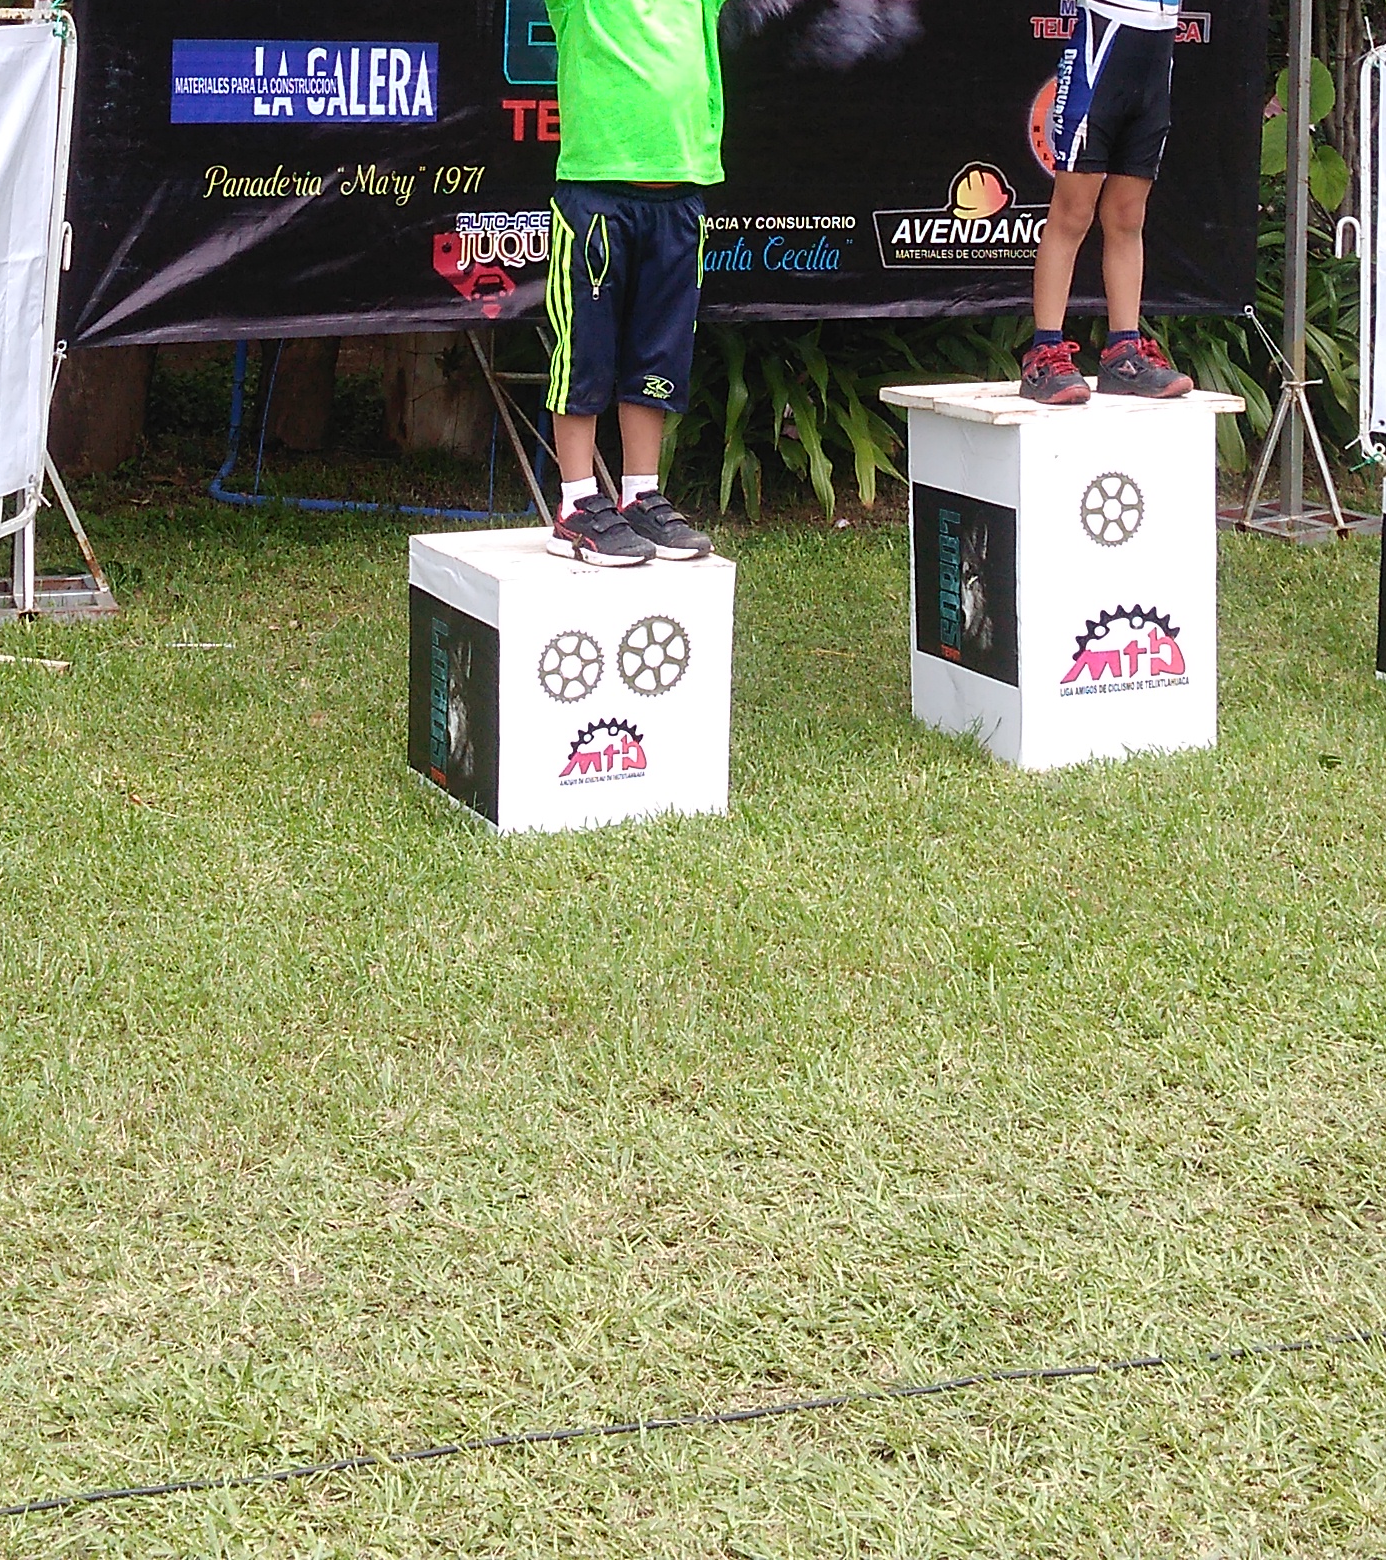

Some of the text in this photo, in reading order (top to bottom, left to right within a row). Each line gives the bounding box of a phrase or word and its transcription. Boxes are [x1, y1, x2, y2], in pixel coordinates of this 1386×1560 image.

[175, 76, 230, 95] MATERIALES
[231, 77, 255, 95] PARA
[257, 78, 269, 95] LA
[433, 166, 486, 194] 1971
[742, 217, 752, 230] Y
[755, 216, 855, 230] CONSULTORIO
[704, 236, 752, 271] anta
[895, 248, 954, 260] MATERIALES
[956, 249, 969, 260] DE
[1099, 683, 1107, 694] DE
[1136, 680, 1144, 690] DE
